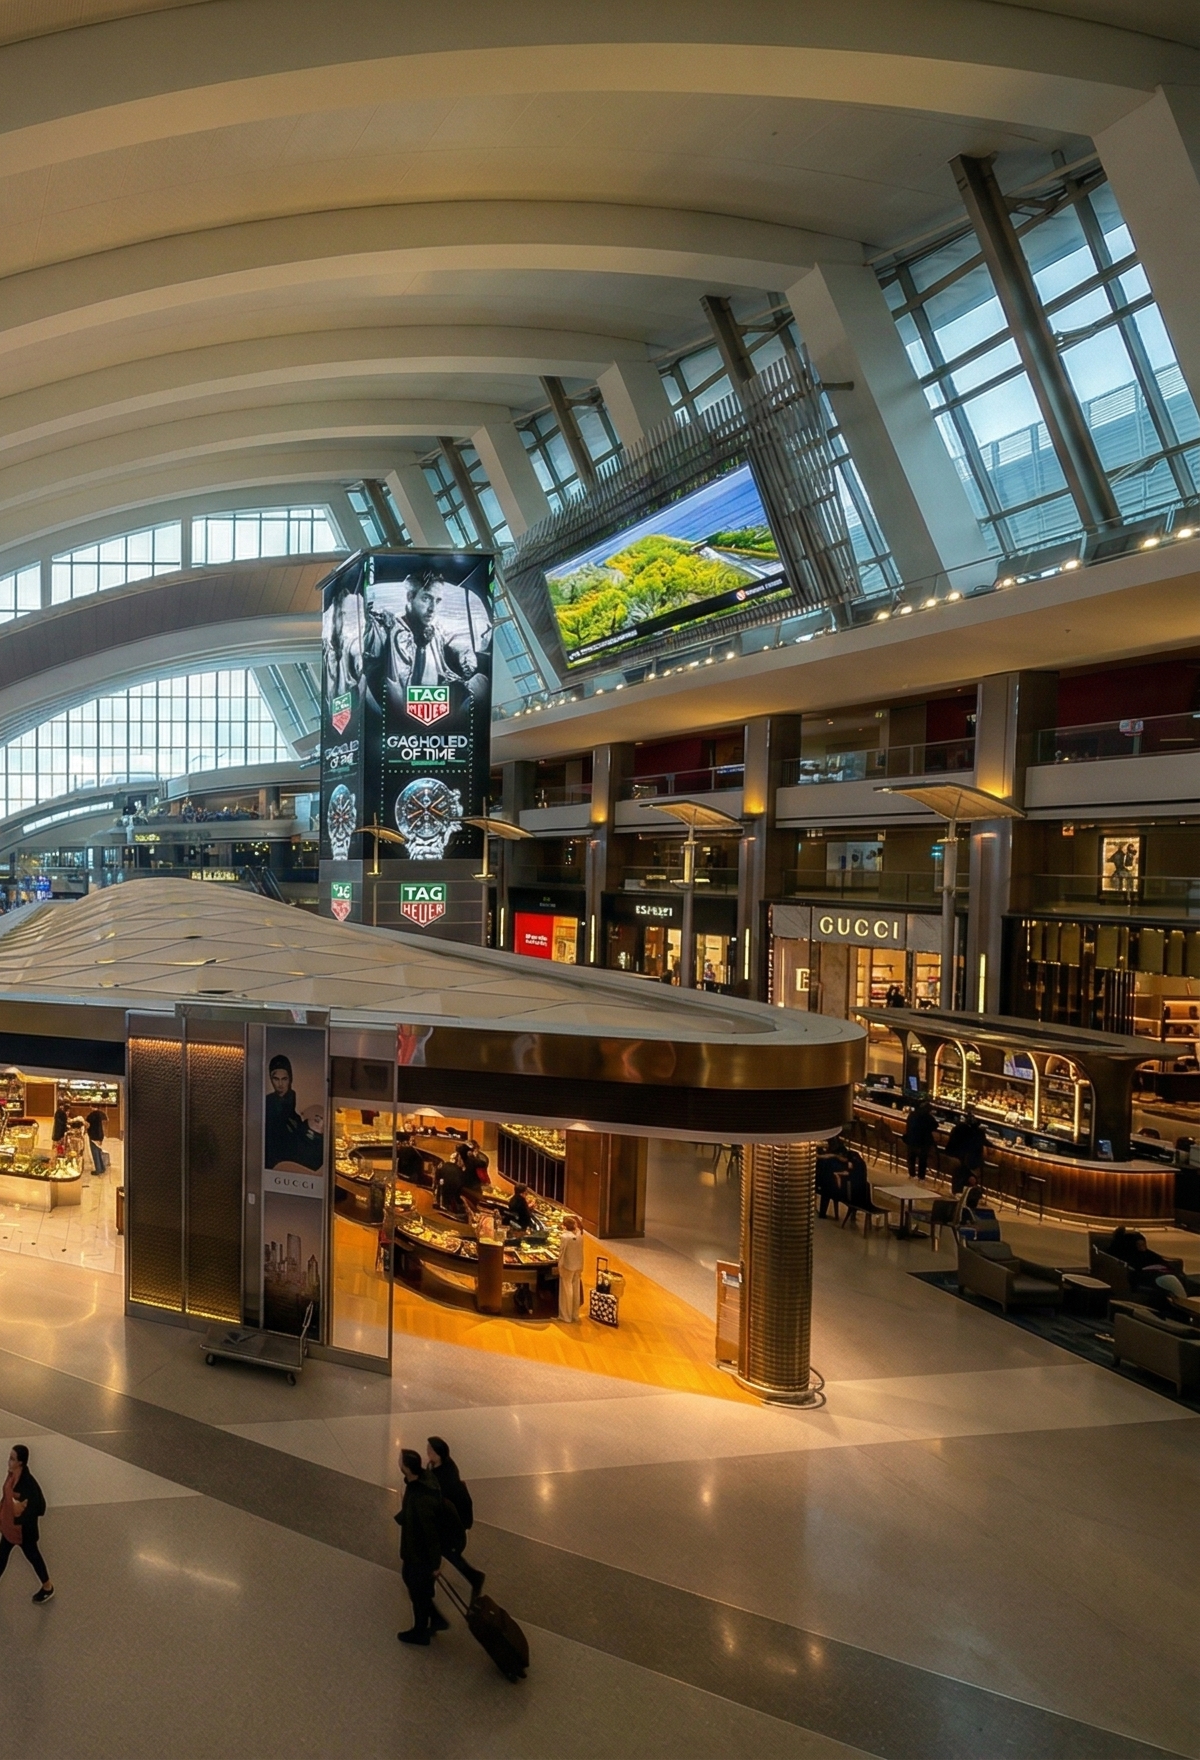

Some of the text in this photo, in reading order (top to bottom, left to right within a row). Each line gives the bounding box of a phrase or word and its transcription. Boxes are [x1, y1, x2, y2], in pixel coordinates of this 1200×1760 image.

[410, 688, 446, 701] TAG
[401, 748, 421, 760] OF
[404, 886, 443, 901] TAG
[403, 903, 443, 924] HEUER
[819, 916, 899, 940] GUCCI
[274, 1176, 314, 1190] GUCCI
